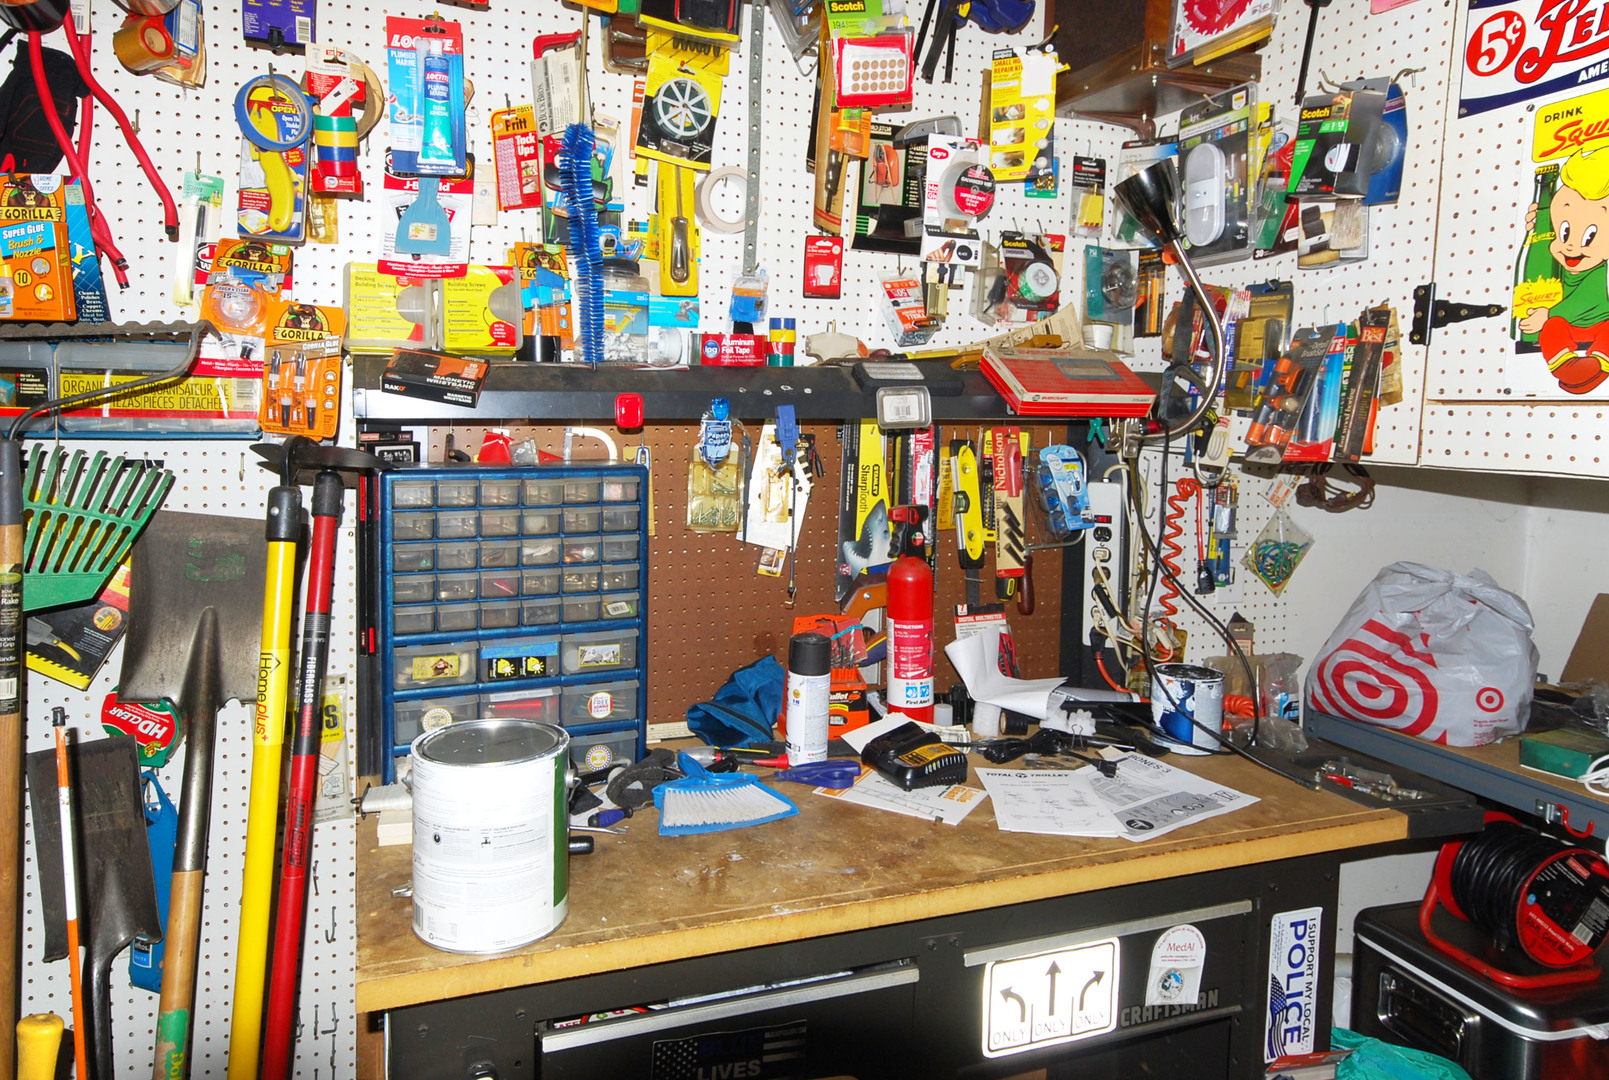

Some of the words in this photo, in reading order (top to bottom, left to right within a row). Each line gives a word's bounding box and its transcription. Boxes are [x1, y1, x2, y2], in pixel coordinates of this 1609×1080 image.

[831, 1, 864, 11] Scotch
[391, 50, 416, 59] PLUMBER
[396, 58, 416, 67] MARINE
[994, 66, 1014, 74] REPAIR
[271, 105, 297, 114] OPEN
[1301, 108, 1330, 119] Scotch
[1544, 106, 1583, 123] DRINK
[505, 117, 527, 132] Fritt
[515, 132, 536, 146] Tack
[518, 145, 535, 157] Ups
[4, 209, 54, 219] GORILLA
[2, 227, 25, 239] SUPER
[27, 223, 45, 234] GLUE
[8, 236, 34, 250] Brush
[1003, 240, 1028, 248] Scotch
[13, 247, 42, 259] Nozzle
[226, 260, 273, 273] GORILLA
[17, 272, 28, 283] 10
[1514, 291, 1561, 306] SQUIRT
[281, 329, 324, 340] GORILLA
[1361, 329, 1383, 343] Best
[721, 338, 755, 346] Aluminum
[721, 346, 734, 354] Foil
[735, 347, 750, 356] Tape
[426, 378, 474, 389] WRISTBAND
[433, 375, 475, 385] MAGNETIC
[384, 384, 406, 392] RAKO
[995, 432, 1007, 490] Nicholson
[872, 465, 880, 496] STANLEY
[859, 464, 870, 513] SharpTooth
[303, 656, 317, 703] FIBERGLASS
[1128, 754, 1163, 770] BONES
[1306, 924, 1316, 978] SUPPORT
[1283, 920, 1308, 1047] POLICE
[1304, 981, 1313, 999] MY
[993, 1028, 1025, 1045] ONLY
[1035, 1019, 1065, 1036] ONLY
[1076, 1012, 1104, 1029] ONLY
[1301, 1003, 1311, 1041] LOCAL
[697, 1058, 761, 1080] LIVES
